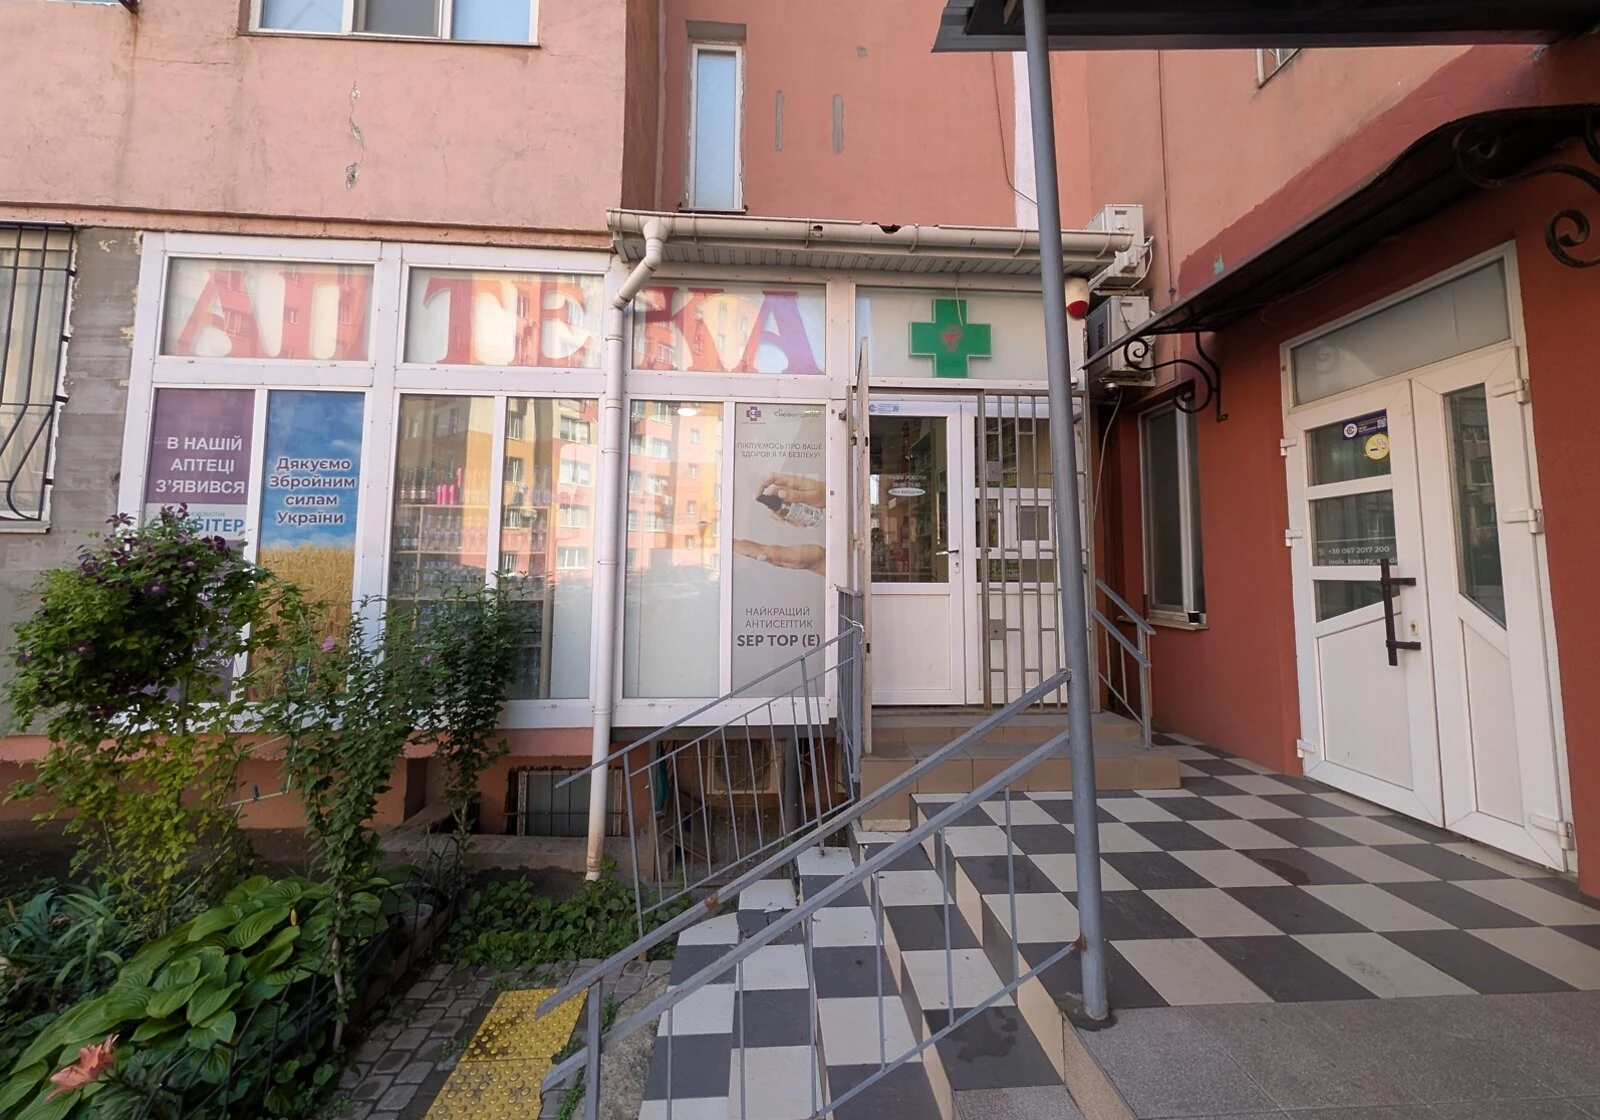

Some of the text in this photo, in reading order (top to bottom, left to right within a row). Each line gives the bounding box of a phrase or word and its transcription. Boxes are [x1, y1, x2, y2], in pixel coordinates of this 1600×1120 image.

[174, 268, 826, 377] АПТЕКА
[167, 435, 243, 451] В НАШІЙ
[737, 442, 784, 450] ПІКЛУЄМОСЬ
[170, 458, 235, 475] АПТЕЦІ
[276, 458, 352, 473] Дякуємо
[269, 475, 356, 490] Збройним
[285, 494, 338, 506] силам
[276, 510, 345, 527] України
[1356, 546, 1373, 554] 2017
[745, 607, 810, 616] НАЙКРАЩИЙ
[745, 619, 813, 628] АНТИСЕПТИК
[737, 634, 821, 648] SEP TOP (E)
